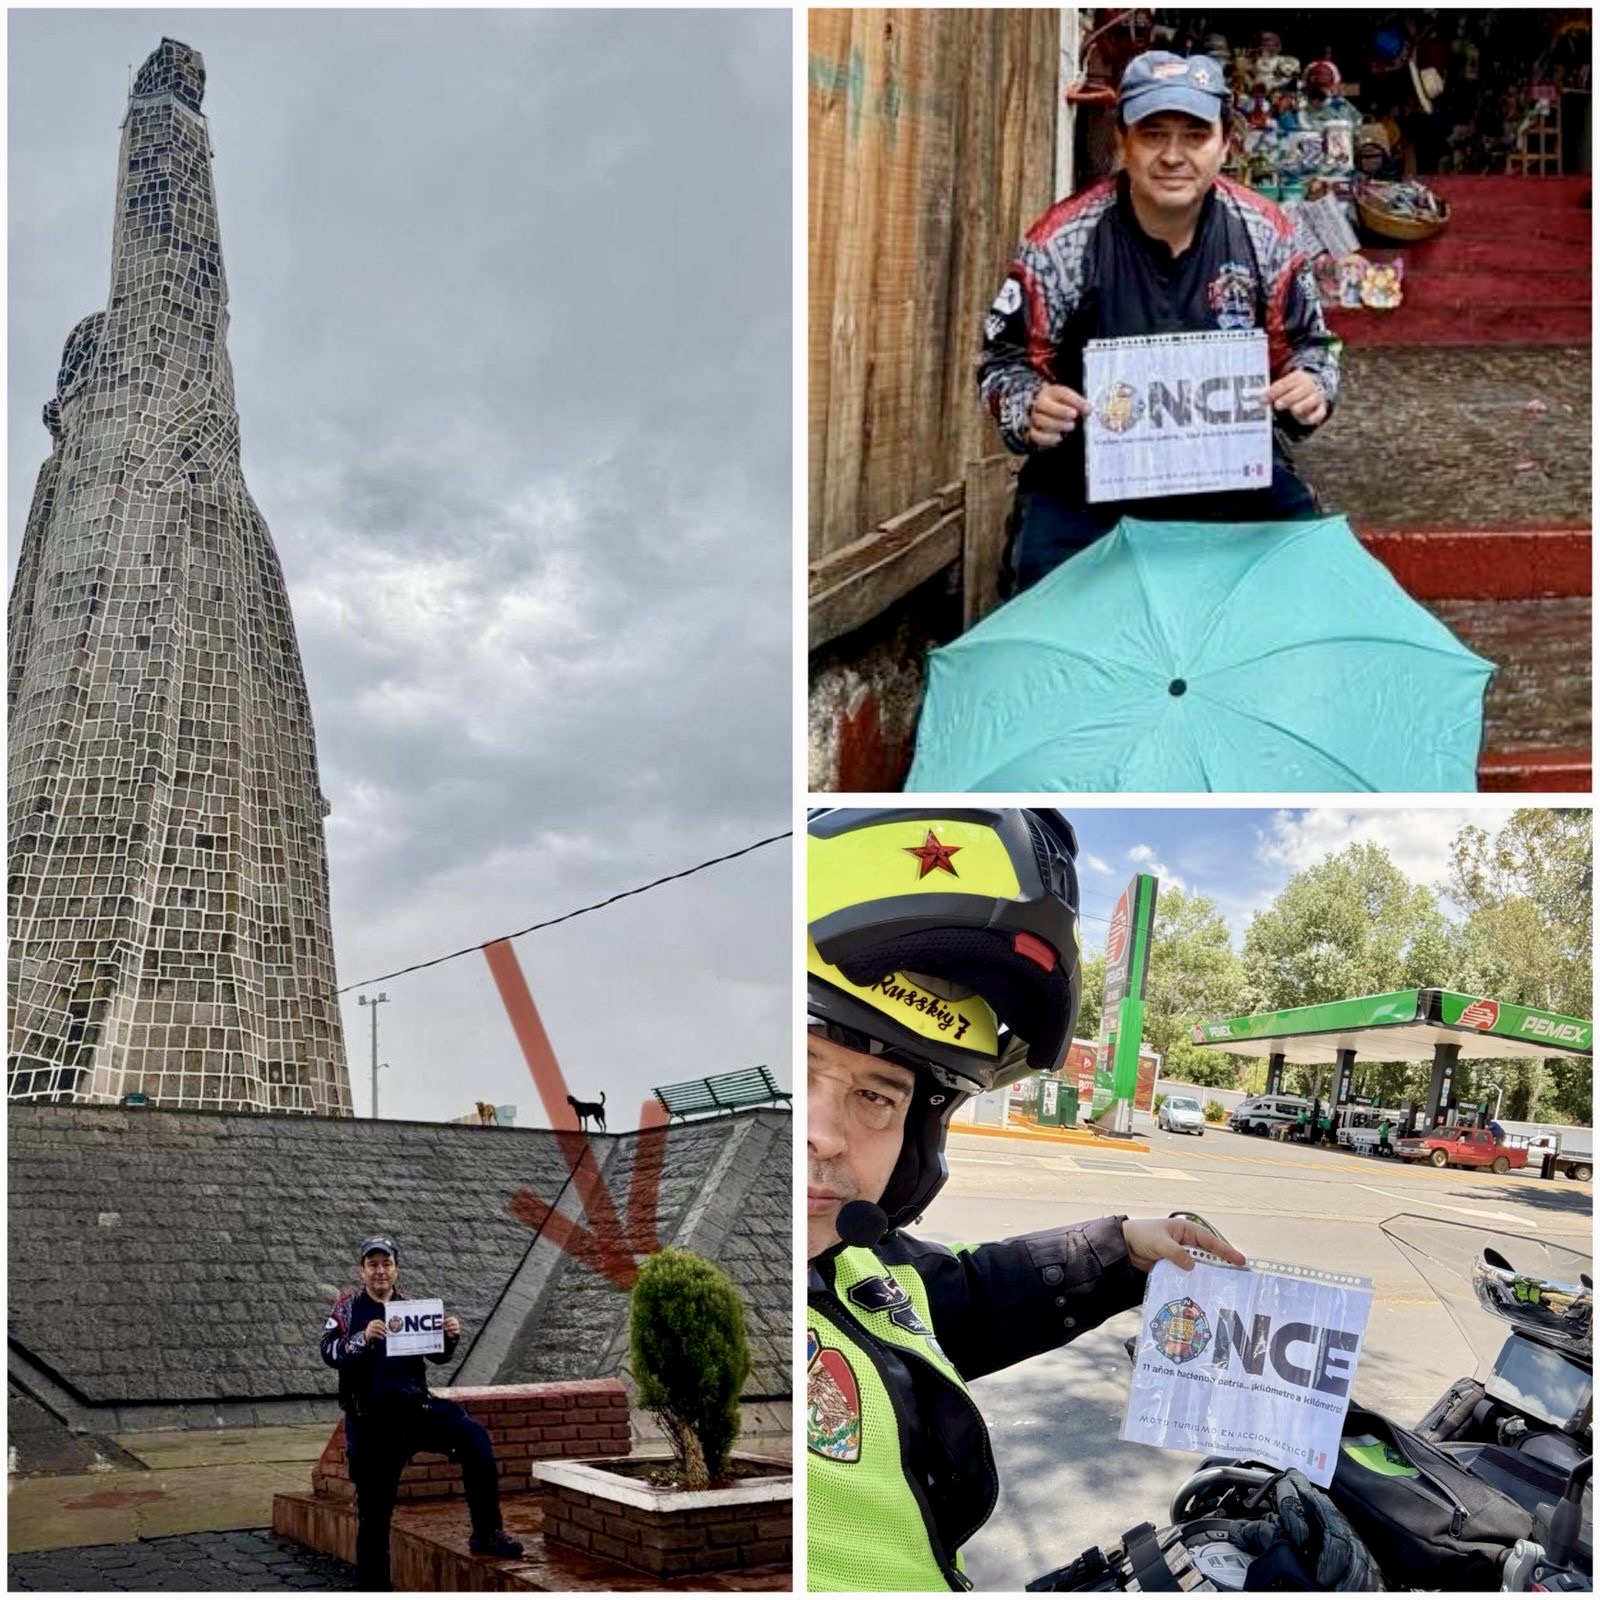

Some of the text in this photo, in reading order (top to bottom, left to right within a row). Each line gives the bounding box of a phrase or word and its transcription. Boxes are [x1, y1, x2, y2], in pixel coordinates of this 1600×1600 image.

[871, 973, 971, 1040] Russkiy 7
[1520, 1015, 1588, 1042] PEMEX
[1142, 1363, 1151, 1372] 11
[1152, 1365, 1175, 1376] años
[1173, 1420, 1217, 1434] TURISMO
[1221, 1428, 1236, 1438] EN
